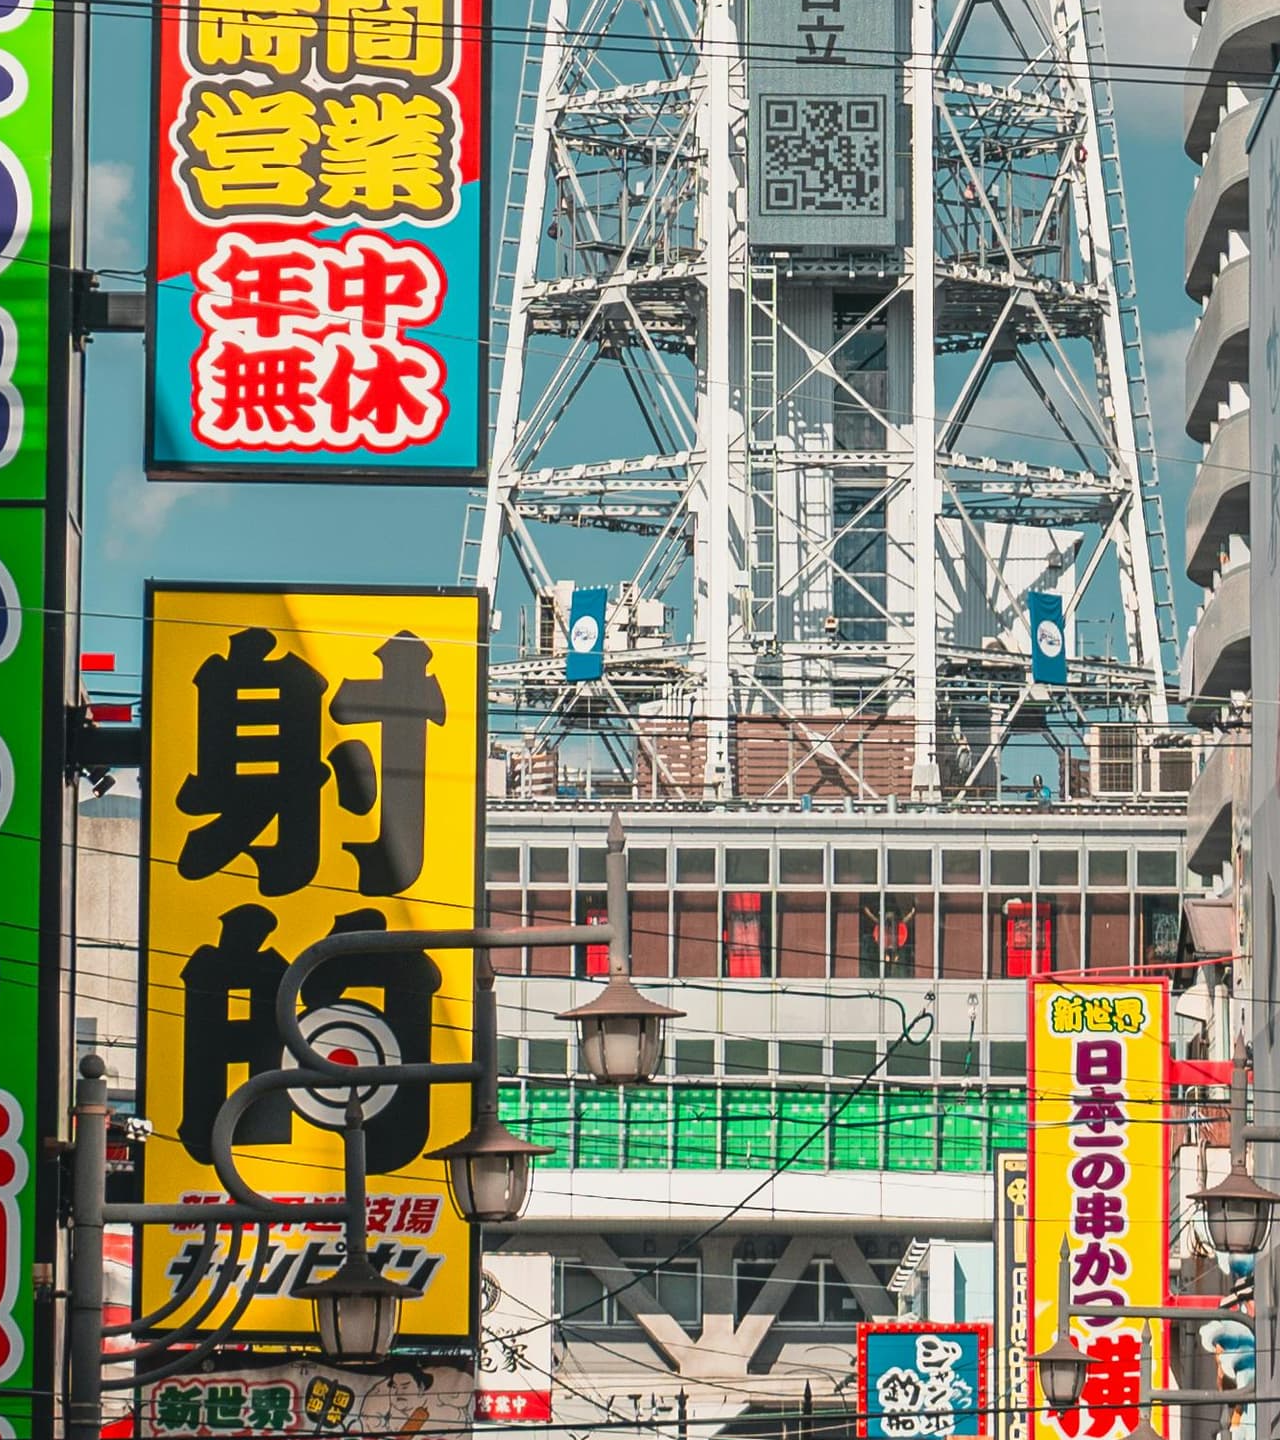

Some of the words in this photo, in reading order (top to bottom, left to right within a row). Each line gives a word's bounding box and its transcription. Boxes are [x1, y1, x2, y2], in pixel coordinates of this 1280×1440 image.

[186, 86, 447, 215] 営業
[205, 237, 438, 337] 年中
[205, 344, 438, 442] 無休
[175, 625, 448, 1175] 射的
[1052, 997, 1146, 1033] 新世界
[157, 1385, 296, 1430] 新世界
